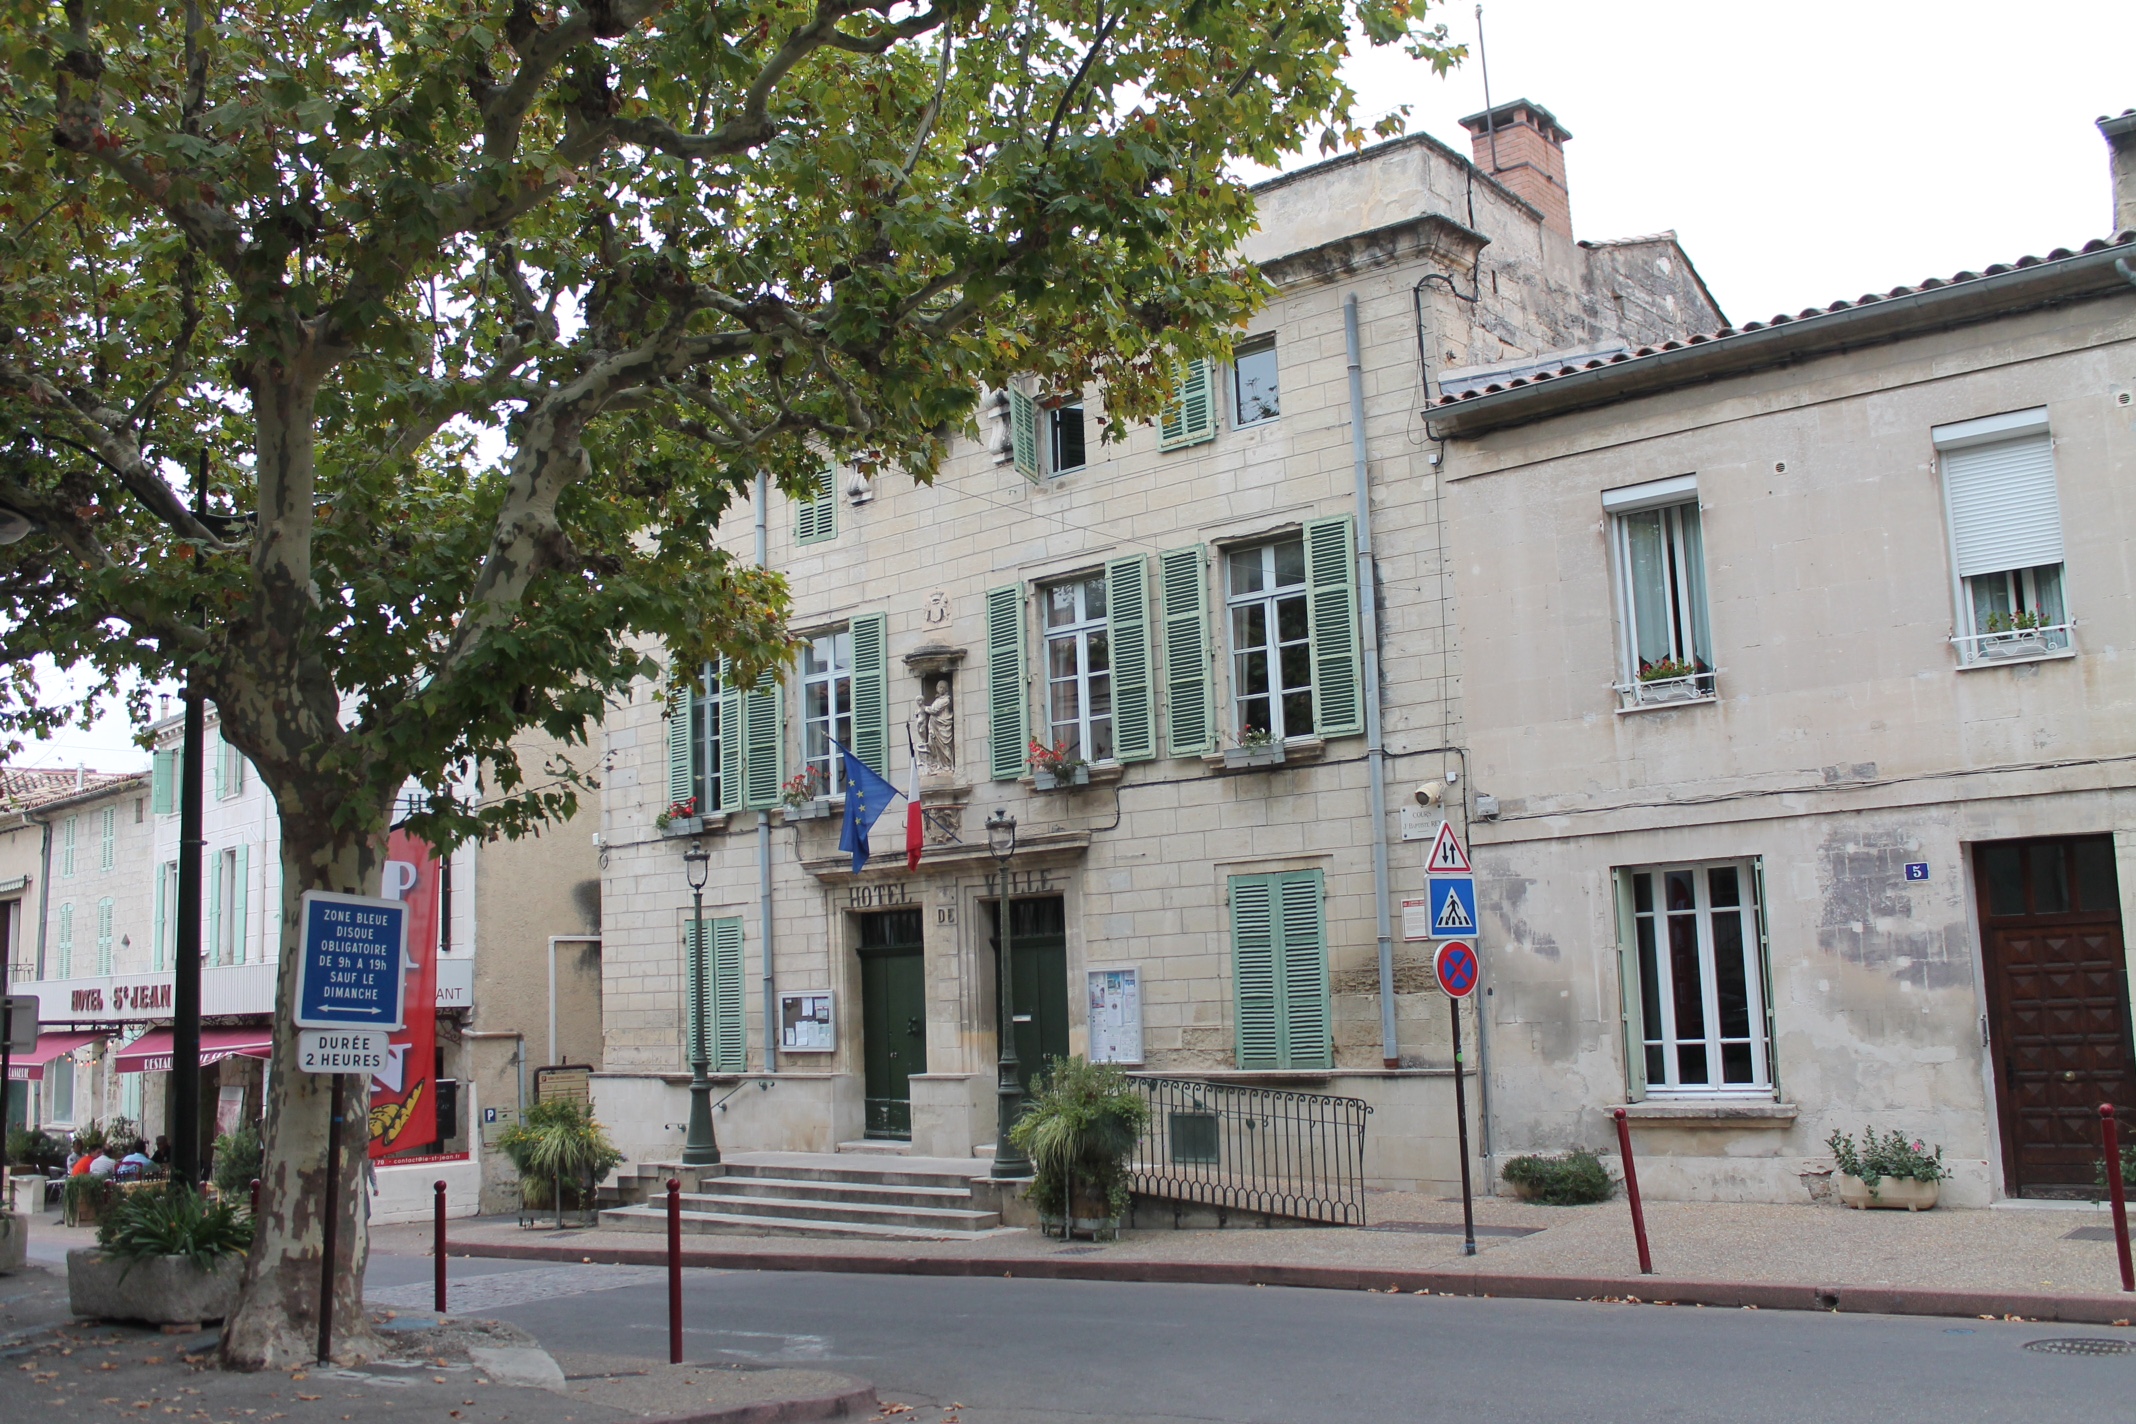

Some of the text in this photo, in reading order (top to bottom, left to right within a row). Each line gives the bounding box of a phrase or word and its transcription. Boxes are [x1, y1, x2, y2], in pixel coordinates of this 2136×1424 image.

[1412, 811, 1432, 819] COURS
[1912, 865, 1922, 878] 5
[983, 868, 1054, 897] VLLE
[323, 909, 389, 926] ZONE BLEUE
[937, 908, 955, 924] DE
[336, 925, 374, 940] DISQUE
[321, 940, 387, 956] OBLIGATOIRE
[319, 955, 387, 971] DE 9h A 19h
[330, 971, 375, 985] SAUF LE
[129, 983, 172, 1010] JEAN
[323, 986, 379, 1000] DIMANCHE
[436, 987, 463, 1000] ANT
[318, 1034, 370, 1050] DURÉE
[305, 1053, 380, 1067] 2 HEURES
[487, 1109, 495, 1121] P
[393, 1154, 461, 1165] contact@le-st-jean.fr
